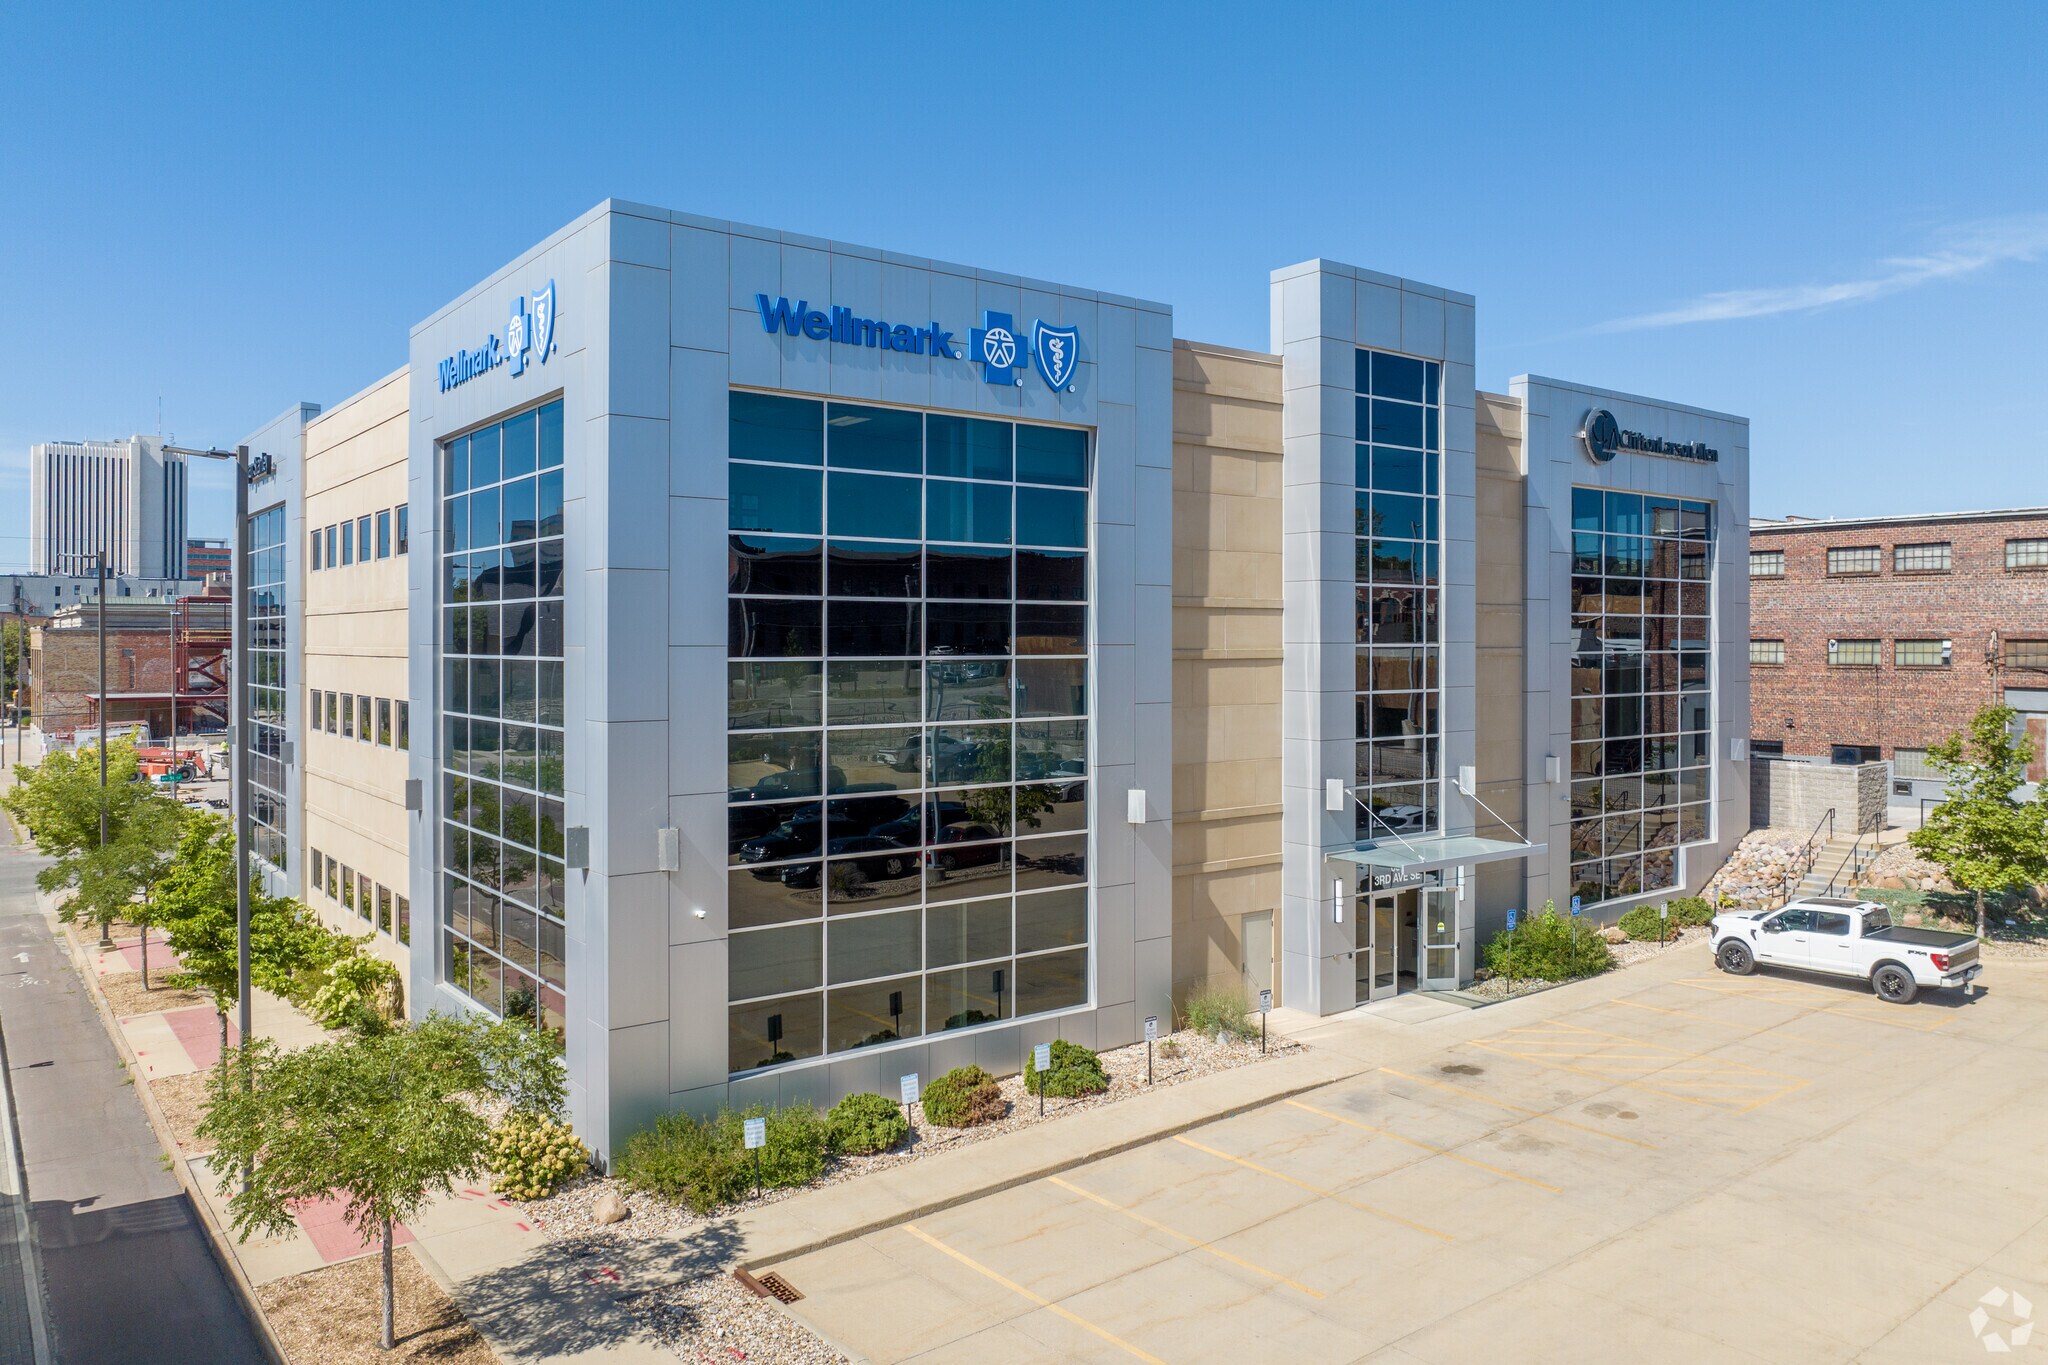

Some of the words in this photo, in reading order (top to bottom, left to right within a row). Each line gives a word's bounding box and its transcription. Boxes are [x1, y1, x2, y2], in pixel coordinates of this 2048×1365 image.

[755, 293, 956, 359] Wellmark
[438, 334, 499, 393] Wellmark
[1374, 873, 1392, 886] 3RD
[1393, 872, 1409, 882] AVE
